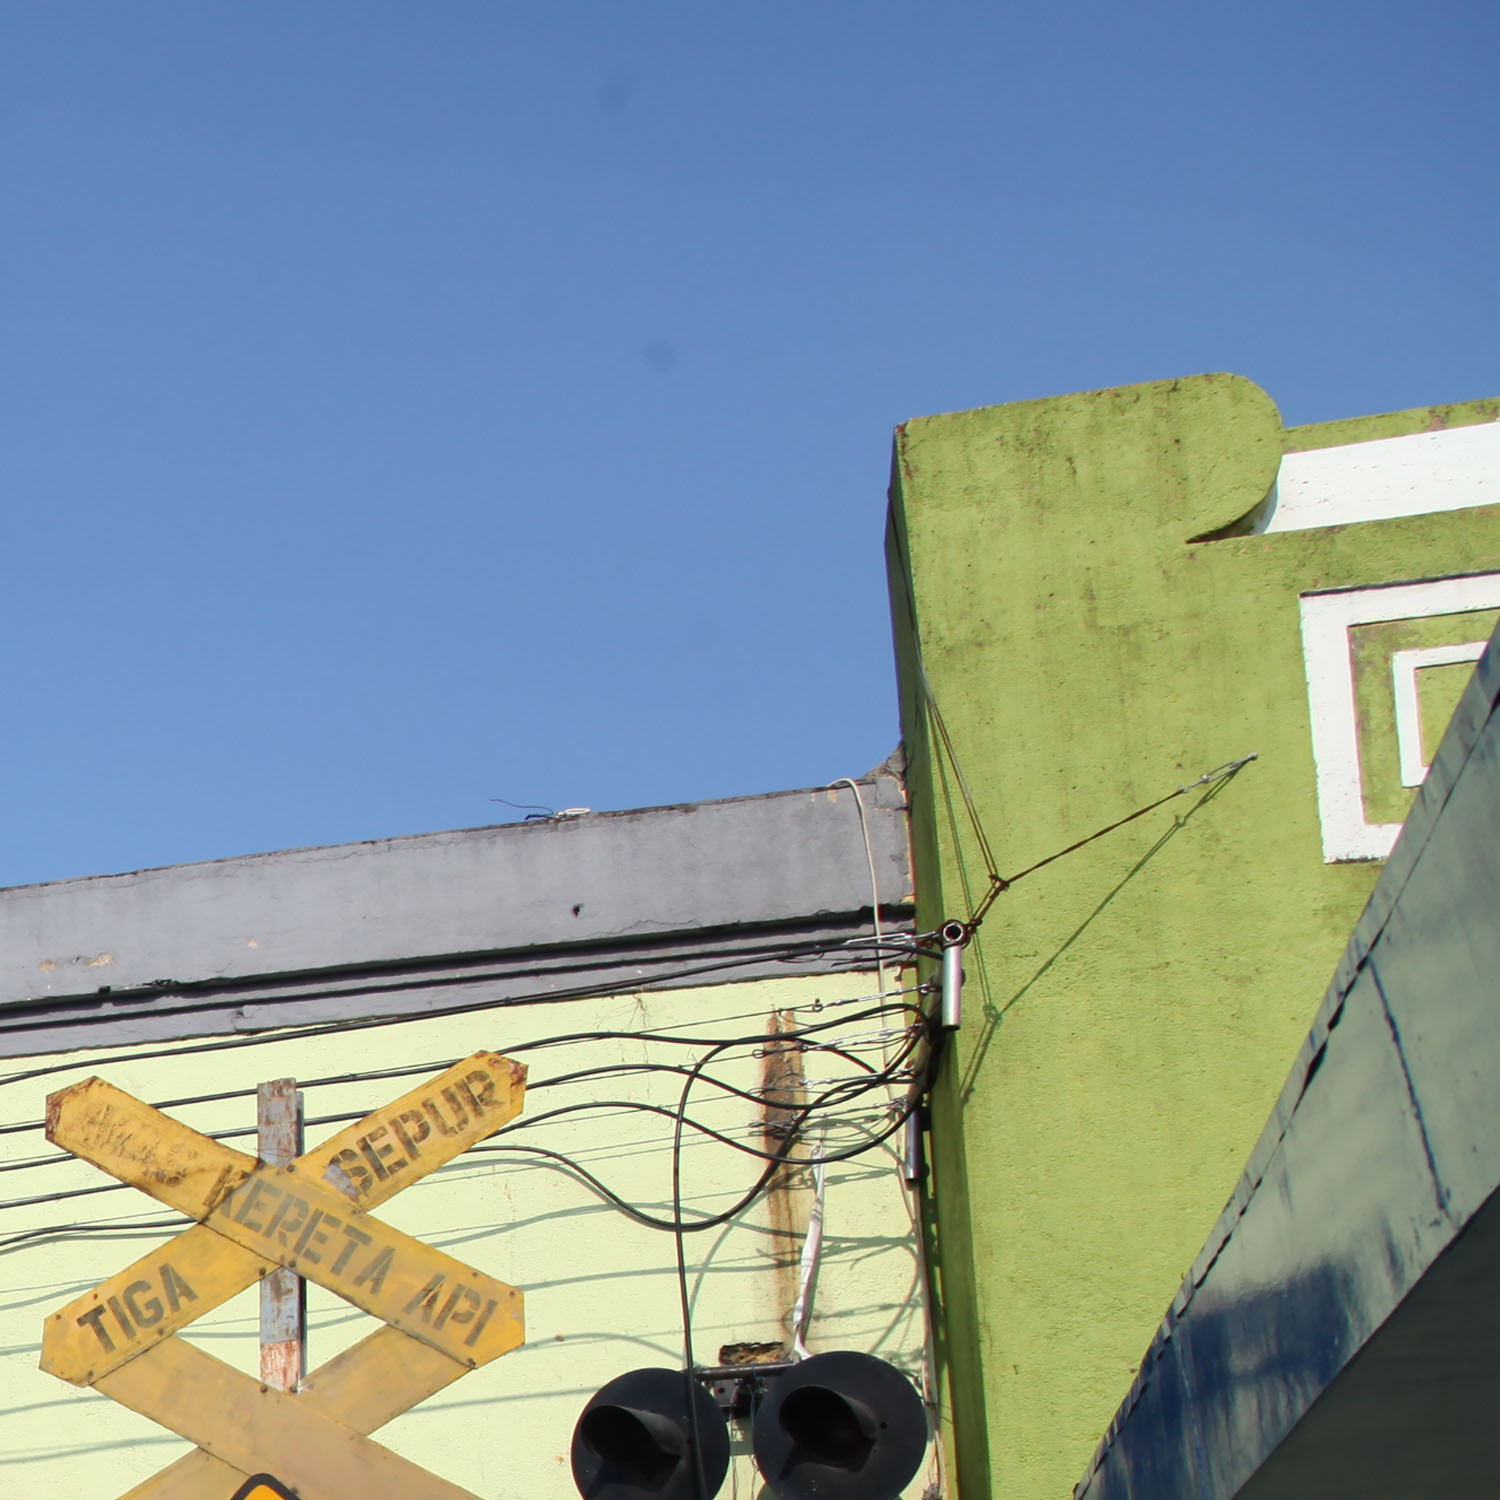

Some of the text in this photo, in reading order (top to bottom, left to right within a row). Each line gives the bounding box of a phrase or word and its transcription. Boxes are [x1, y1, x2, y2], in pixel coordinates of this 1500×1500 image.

[328, 1070, 506, 1200] SEPUR
[76, 1263, 198, 1354] TIGA
[202, 1162, 498, 1348] KERETA API
